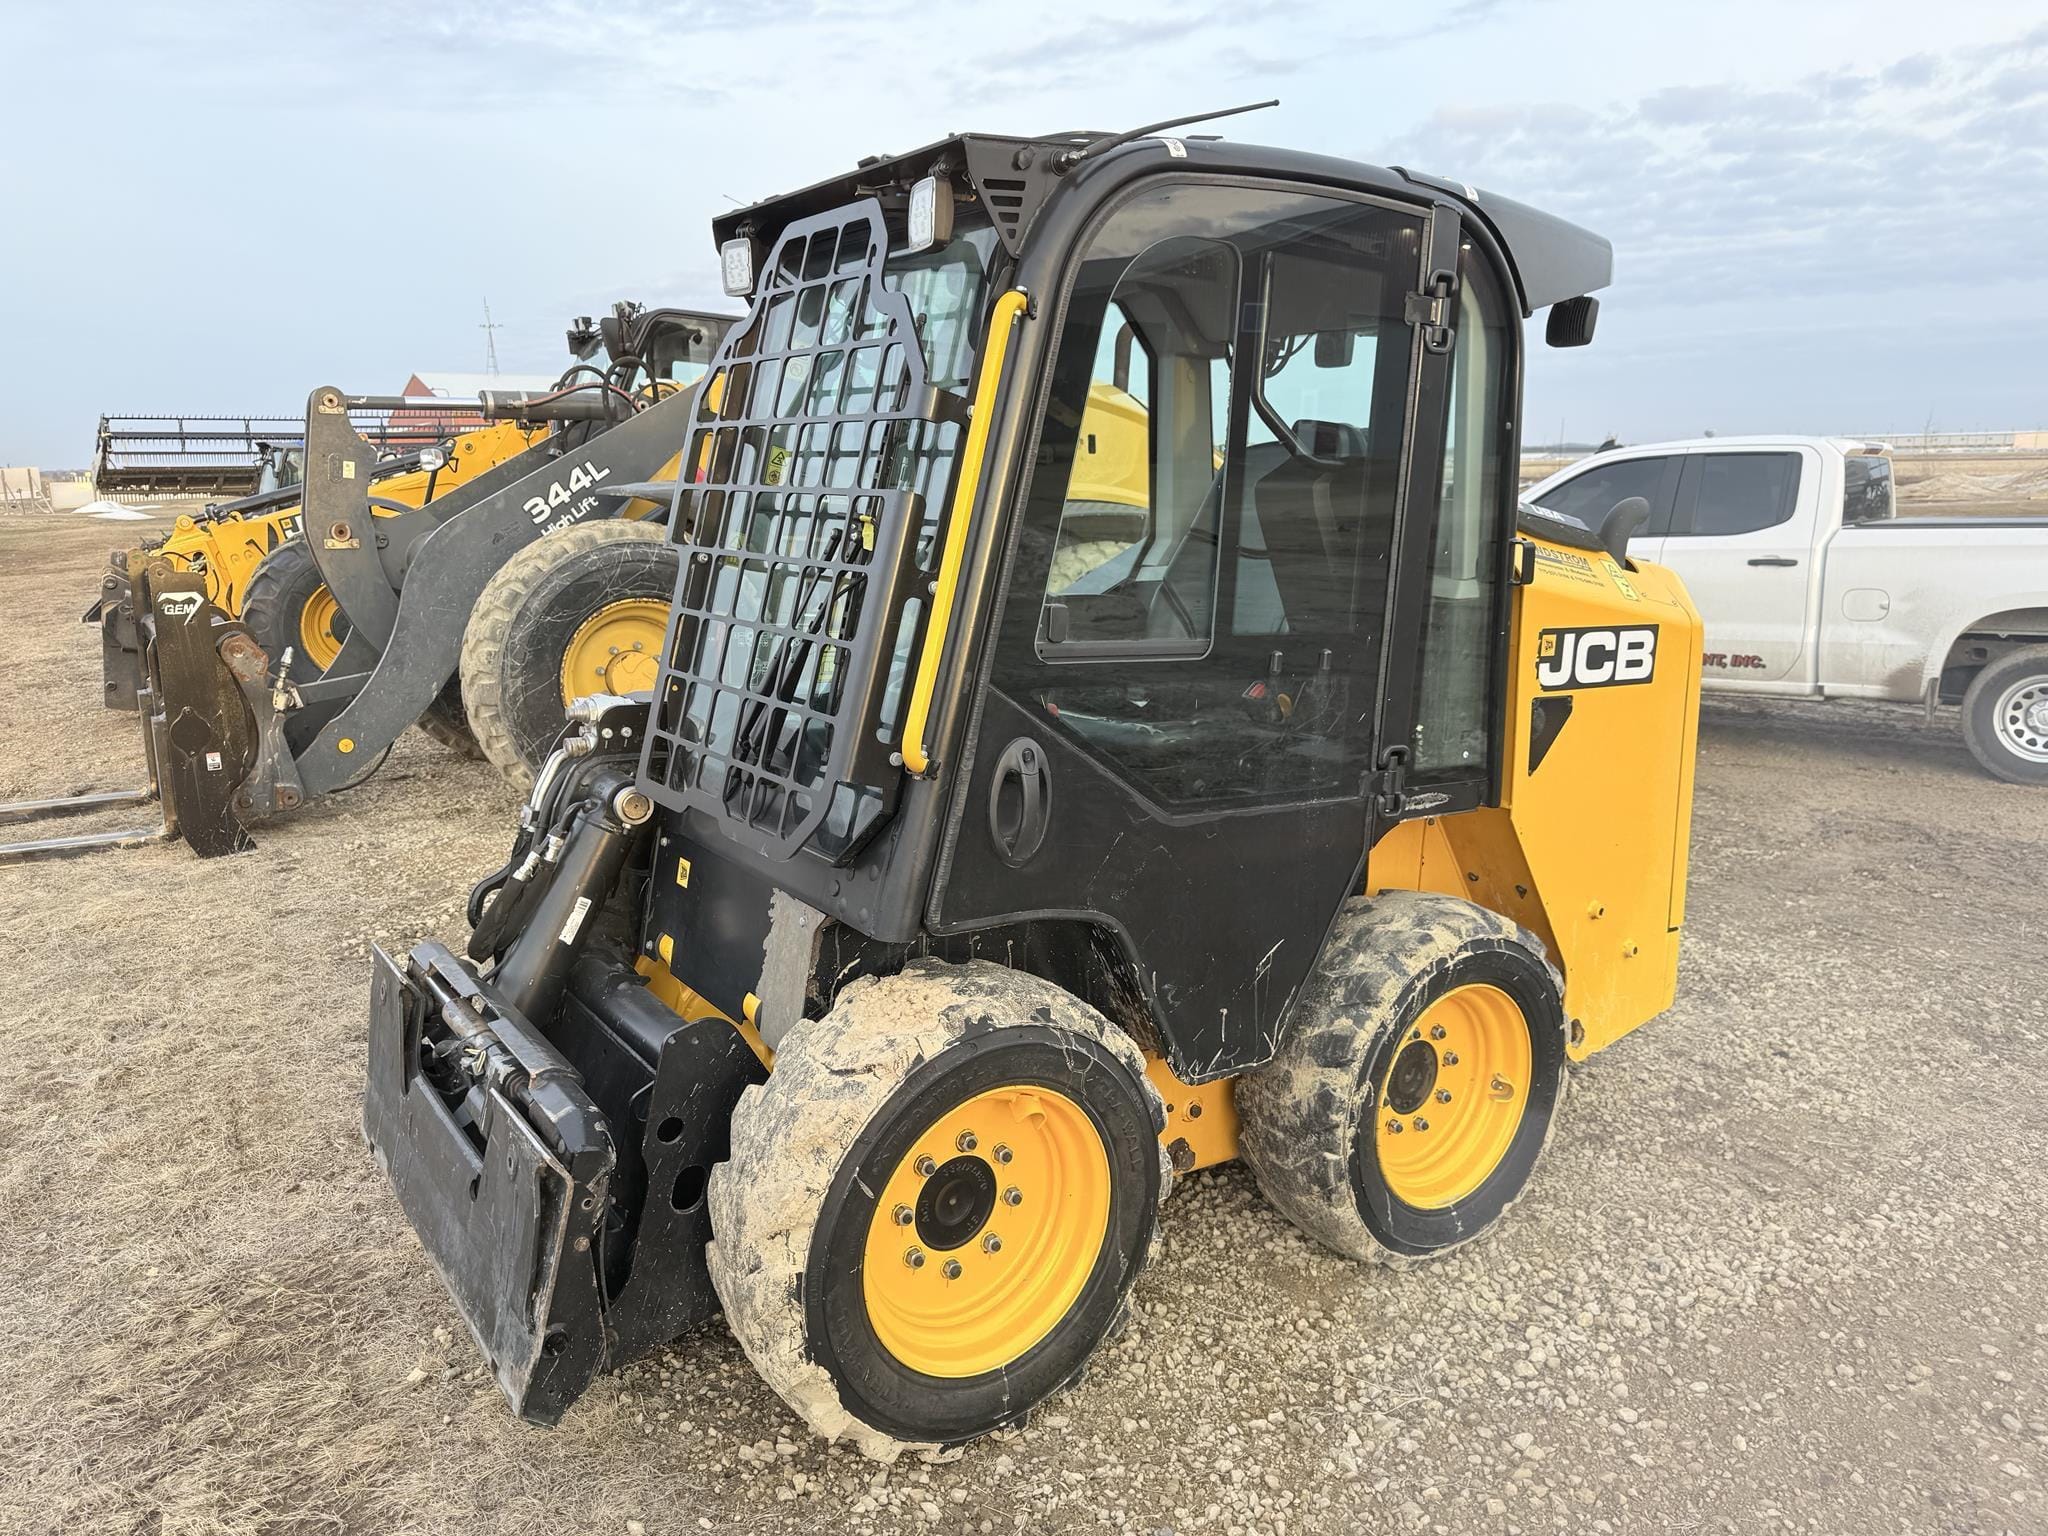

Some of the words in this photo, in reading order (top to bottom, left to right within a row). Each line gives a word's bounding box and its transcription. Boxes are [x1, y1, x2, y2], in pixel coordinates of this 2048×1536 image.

[523, 460, 610, 525] 344L
[570, 496, 599, 518] Lift
[164, 603, 195, 616] GEM
[1538, 629, 1655, 687] JCB
[1730, 654, 1766, 669] INC.
